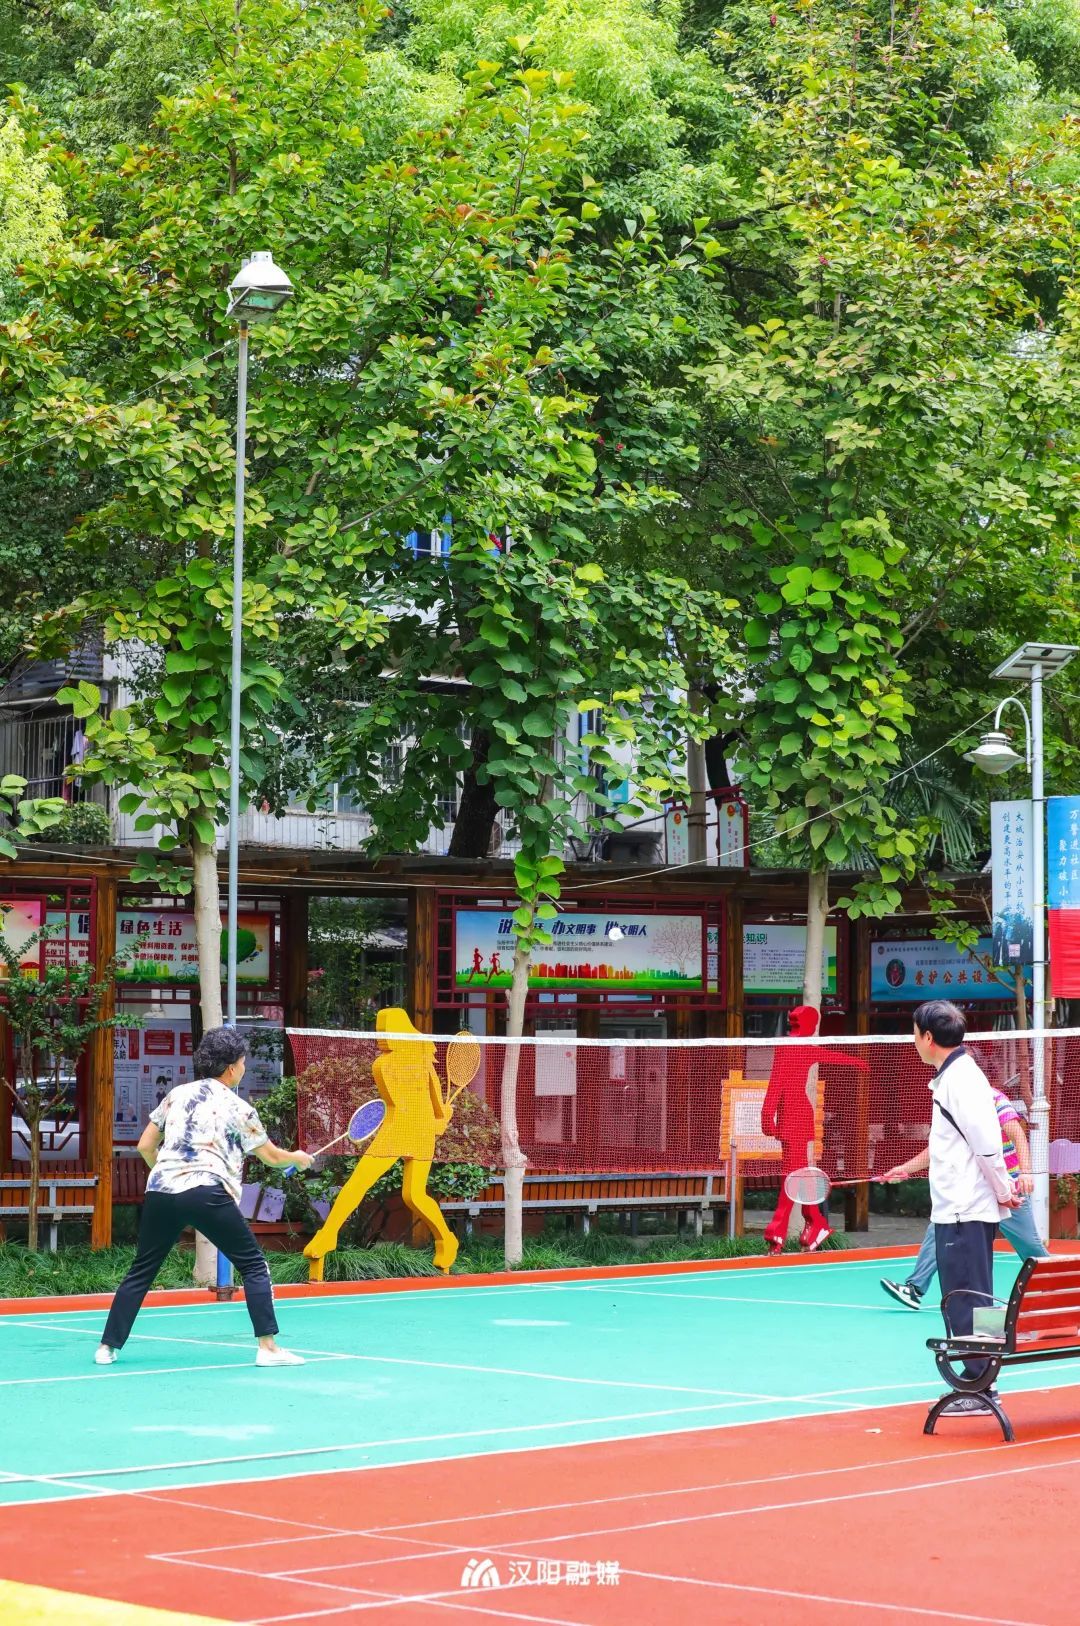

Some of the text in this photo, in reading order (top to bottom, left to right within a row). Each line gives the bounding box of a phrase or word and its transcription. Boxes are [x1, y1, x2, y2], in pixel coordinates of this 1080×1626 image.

[1058, 839, 1068, 903] 聚力破小
[120, 920, 182, 935] 绿色生活
[551, 920, 597, 935] 办文明事
[743, 933, 767, 944] 知识
